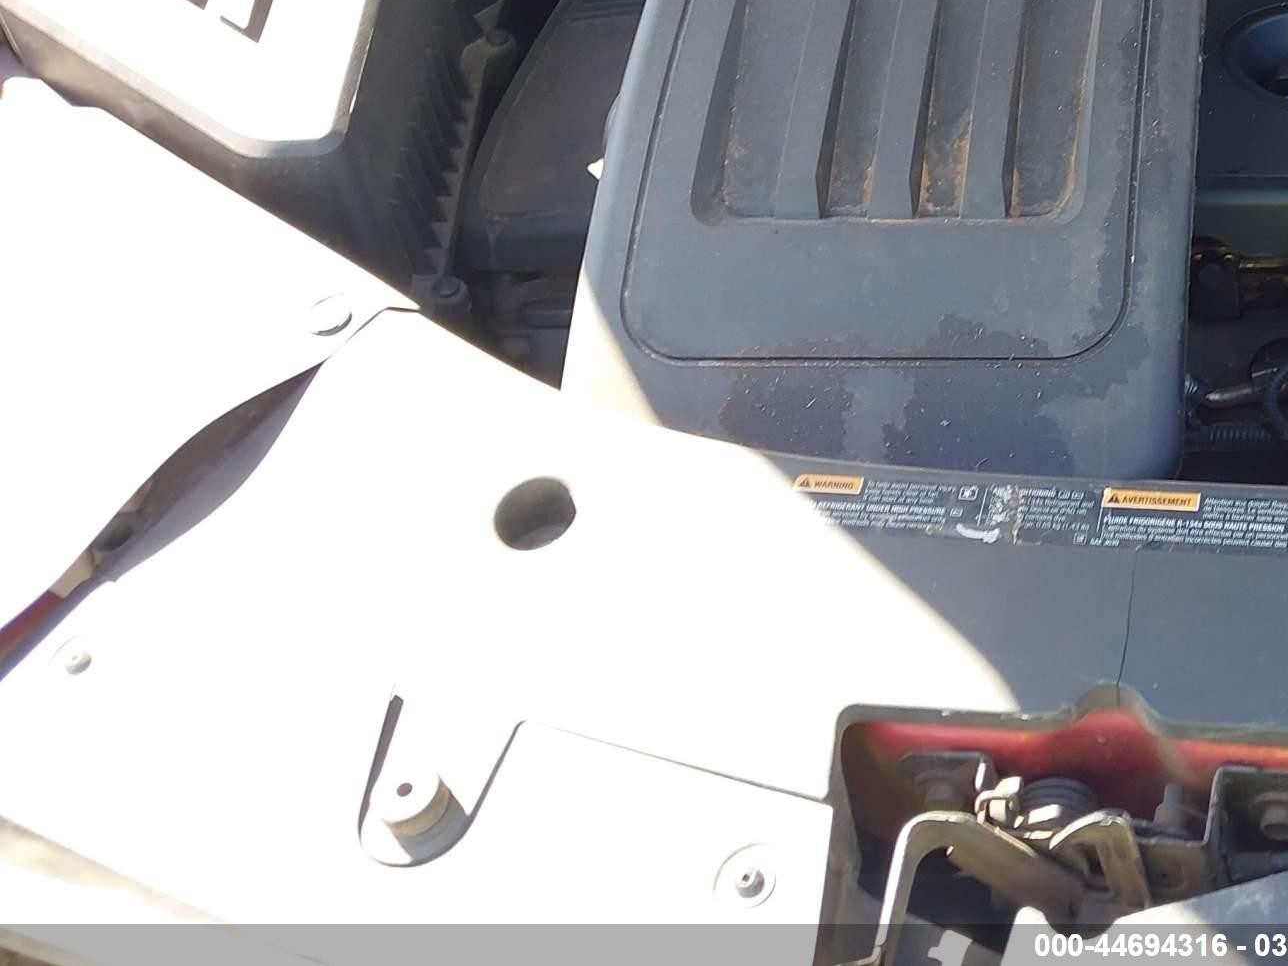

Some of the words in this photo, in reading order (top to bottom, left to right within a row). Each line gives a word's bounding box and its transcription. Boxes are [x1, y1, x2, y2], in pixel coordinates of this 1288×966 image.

[813, 480, 855, 491] WARNING
[1122, 495, 1193, 507] AVERTISSEMENT
[866, 503, 890, 513] UNDER
[891, 505, 909, 514] HIGH
[909, 506, 946, 517] PRESSURE
[1224, 522, 1249, 531] HAUTE
[1249, 523, 1285, 533] PRESSION
